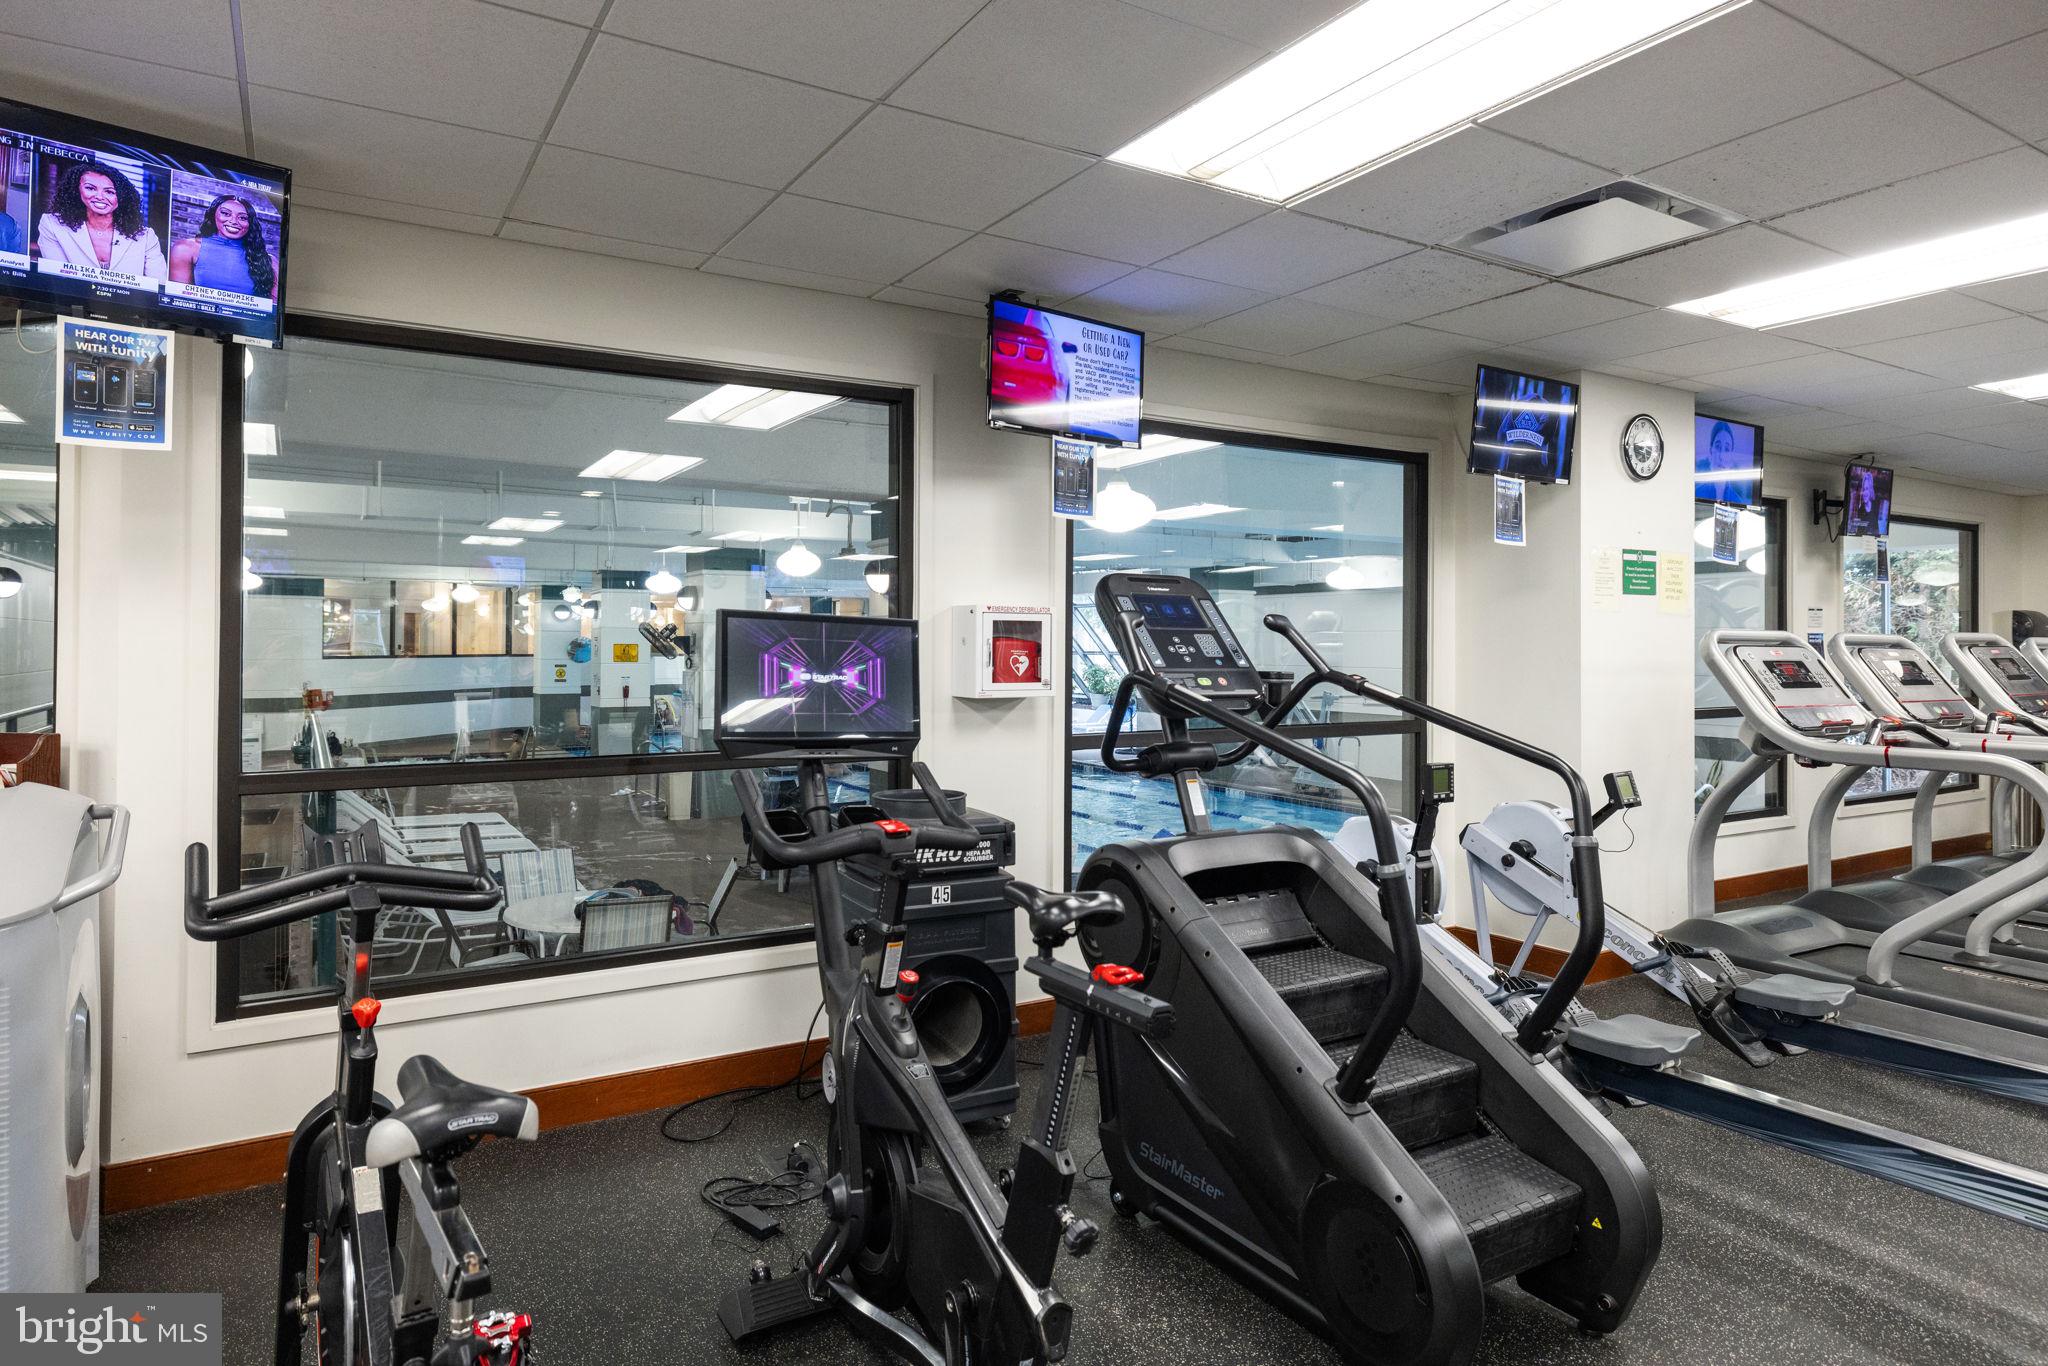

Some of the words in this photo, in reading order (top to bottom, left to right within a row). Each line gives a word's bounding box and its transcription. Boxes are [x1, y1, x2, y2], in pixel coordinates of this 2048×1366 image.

[20, 140, 34, 150] IN
[40, 144, 89, 163] REBECCA
[63, 263, 96, 275] MALIKA
[99, 270, 136, 282] ANDREWS
[185, 284, 215, 295] CHINEY
[217, 290, 255, 303] OGWUMIKE
[75, 329, 107, 341] HEAR
[109, 334, 134, 345] OUR
[137, 337, 157, 348] TVs
[1082, 326, 1108, 344] GETTING
[1110, 334, 1115, 345] A
[1117, 335, 1131, 348] NEW
[75, 341, 107, 354] WITH
[111, 345, 156, 362] tunity
[1083, 342, 1092, 354] OR
[1095, 344, 1110, 358] USED
[1112, 348, 1129, 364] CAR?
[73, 428, 156, 439] WWW.TUNITY.COM
[1507, 430, 1542, 445] WILDERNESS
[1057, 443, 1068, 451] HEAR
[1070, 452, 1089, 463] tunity
[914, 848, 963, 863] IKRO
[963, 855, 994, 863] SCRUBBER
[933, 887, 949, 903] 45
[452, 1118, 474, 1126] STAR
[475, 1114, 495, 1123] TRAC
[1140, 1141, 1220, 1200] StairMaster
